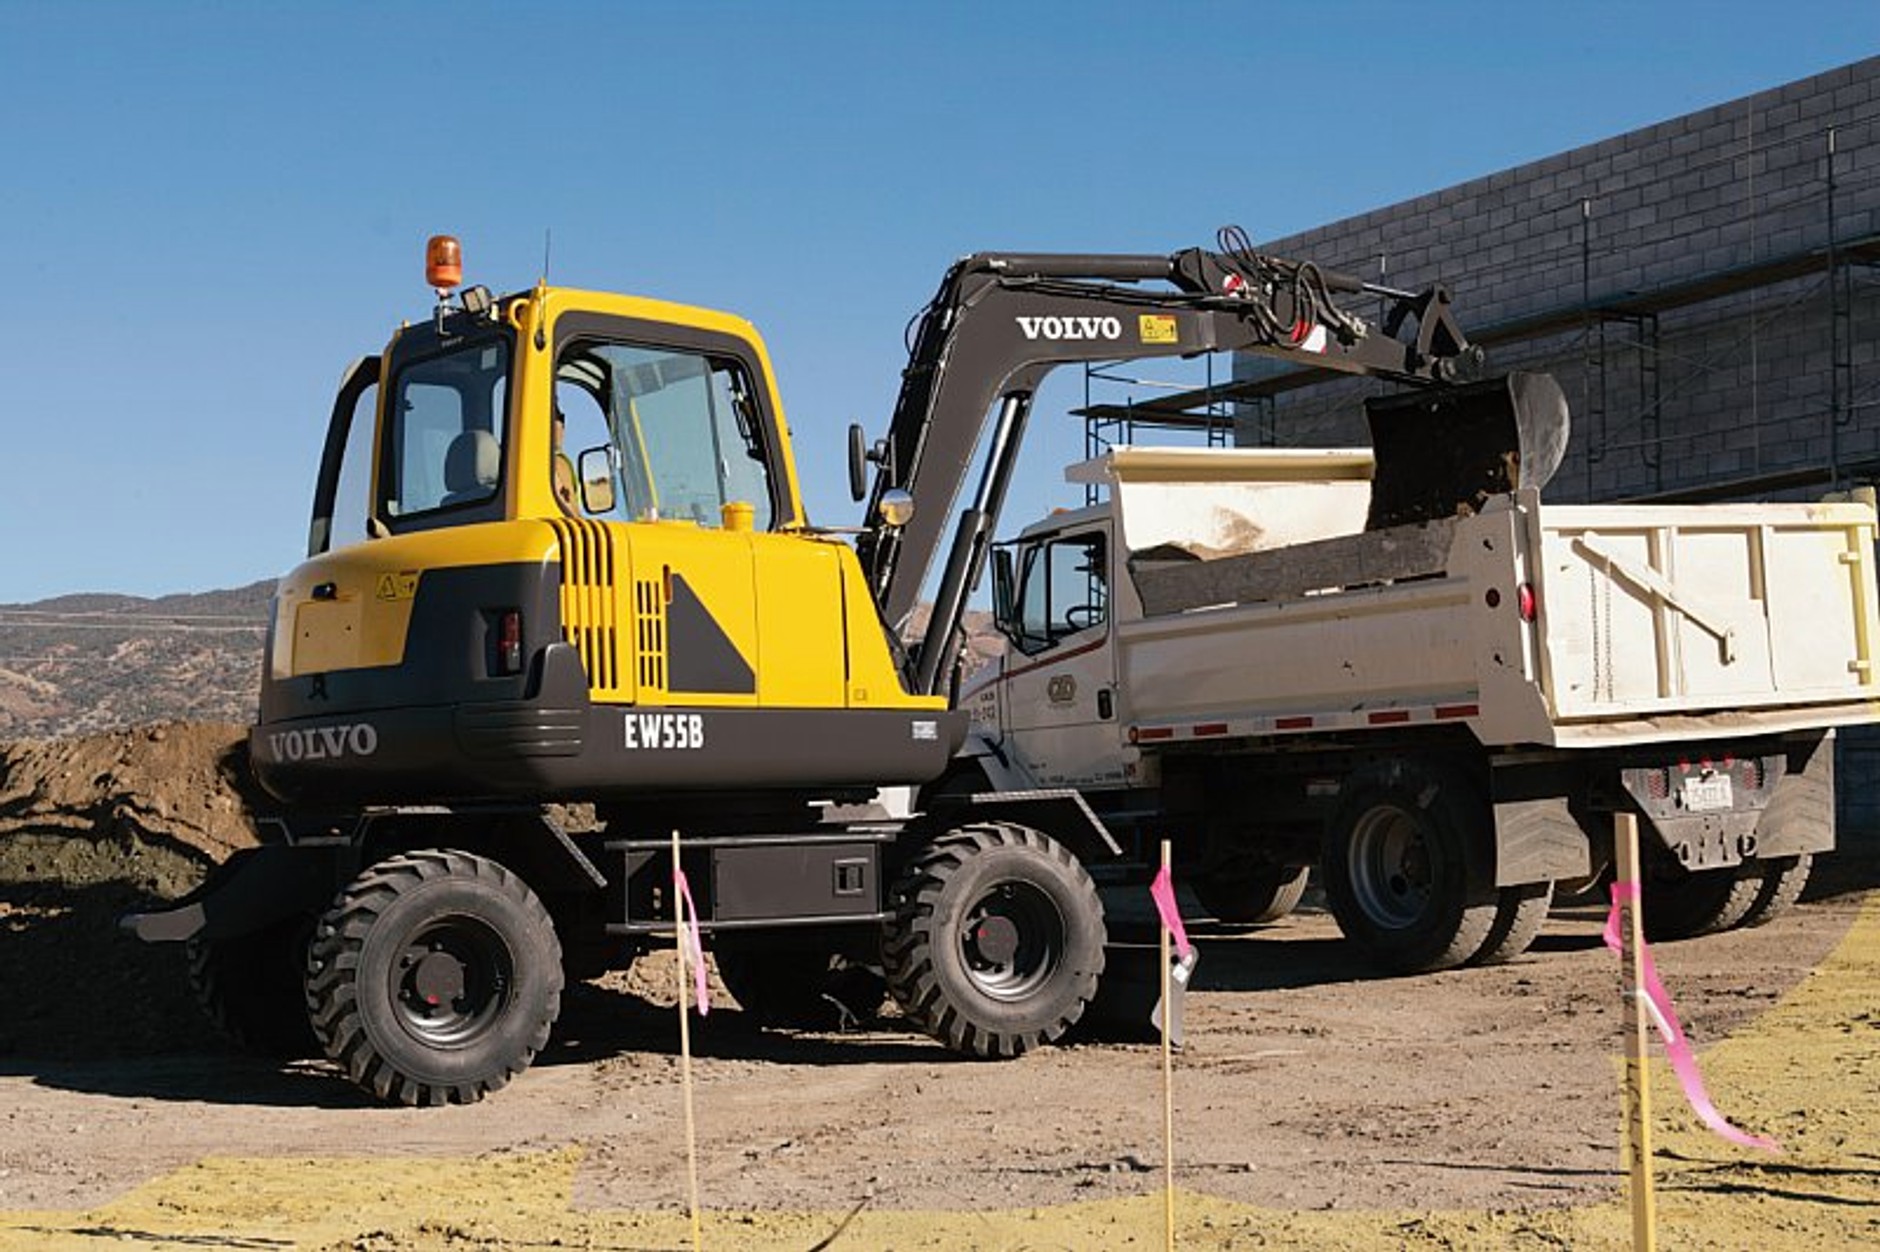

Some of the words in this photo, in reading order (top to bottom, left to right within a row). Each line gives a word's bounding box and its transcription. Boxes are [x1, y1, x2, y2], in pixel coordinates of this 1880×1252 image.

[1016, 316, 1122, 340] VOLVO
[270, 723, 378, 762] VOLVO
[625, 714, 704, 748] EW55B
